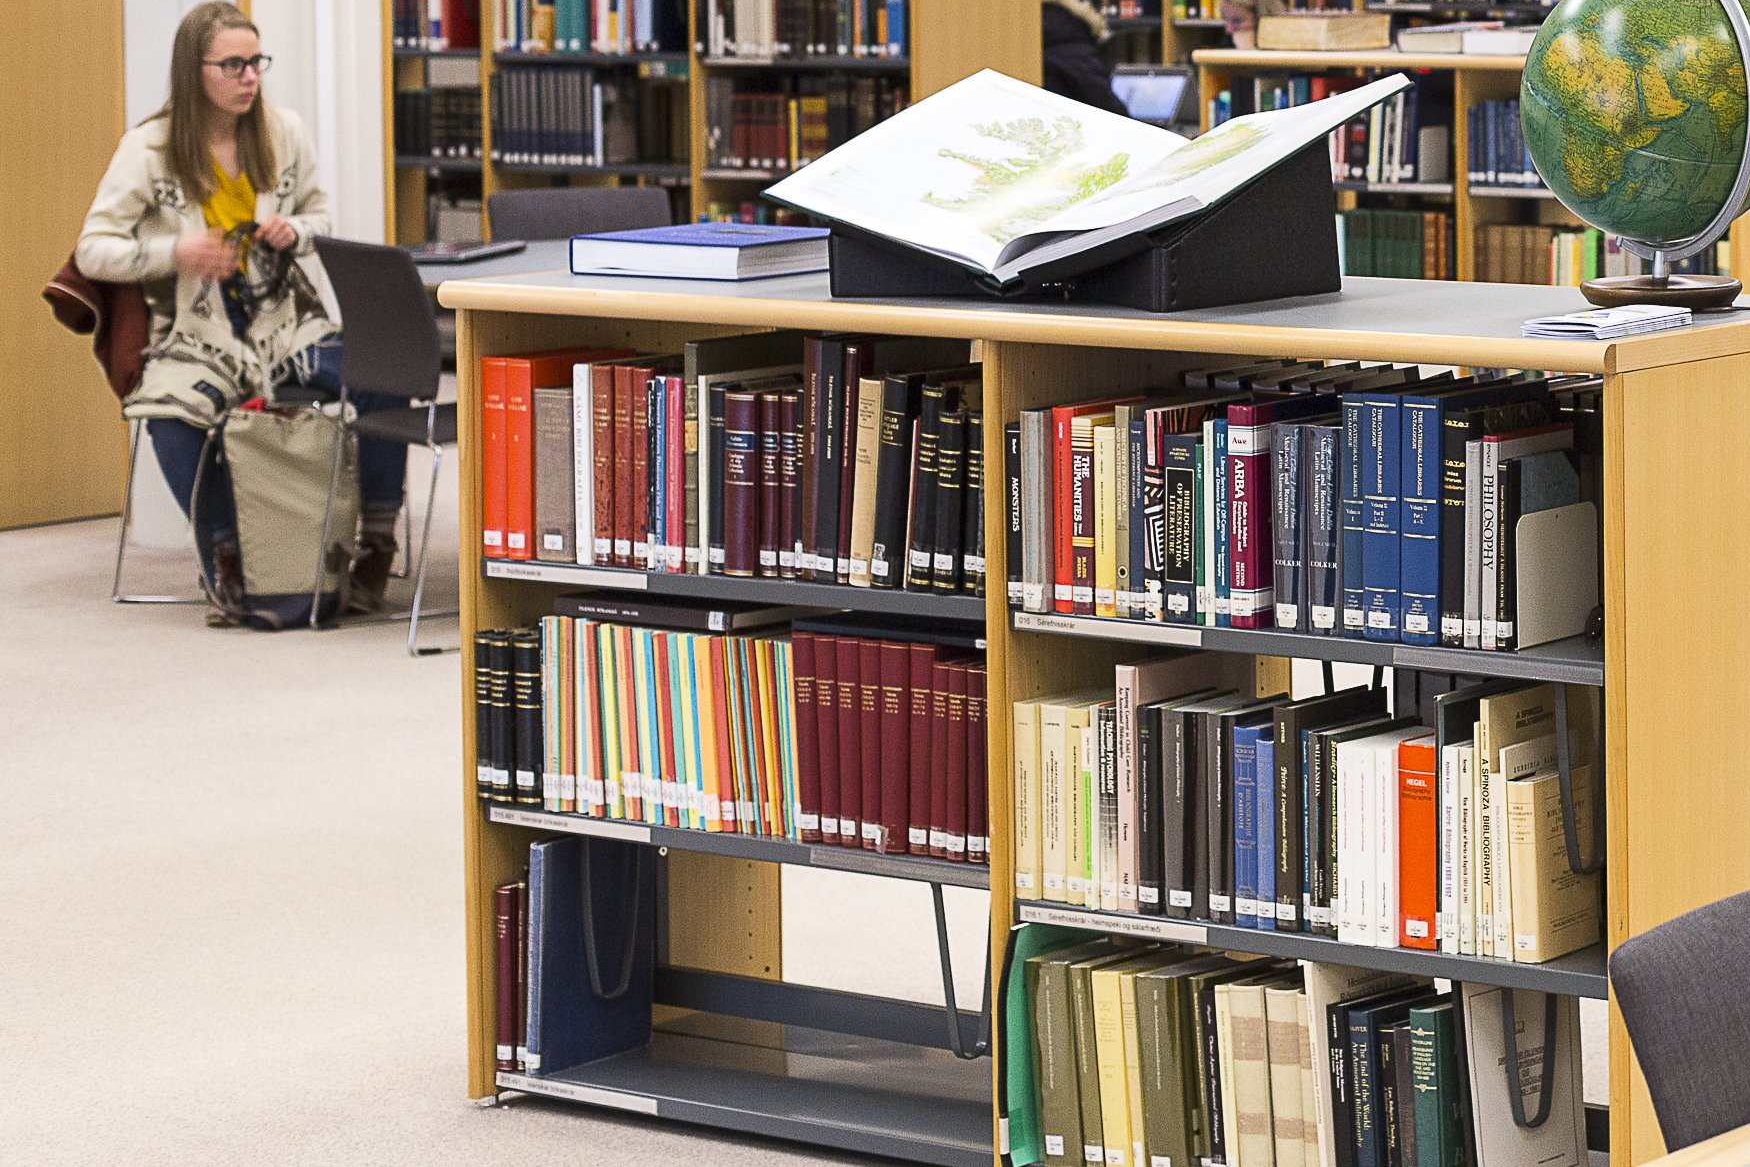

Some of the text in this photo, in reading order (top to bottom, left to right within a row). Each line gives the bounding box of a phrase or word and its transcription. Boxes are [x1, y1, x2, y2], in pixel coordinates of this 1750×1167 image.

[1082, 456, 1090, 478] THE
[1074, 456, 1082, 522] HUMANITIES
[1234, 459, 1245, 498] ARBA
[1012, 477, 1020, 532] MONSTERS
[1483, 475, 1494, 570] PHILOSOPHY
[1275, 559, 1302, 568] COLKER
[1310, 560, 1338, 569] COLKER
[1406, 778, 1427, 787] HEGEL
[1483, 815, 1491, 886] BIBLIOGRAPHY
[1352, 1042, 1358, 1053] An
[1362, 1079, 1369, 1088] of
